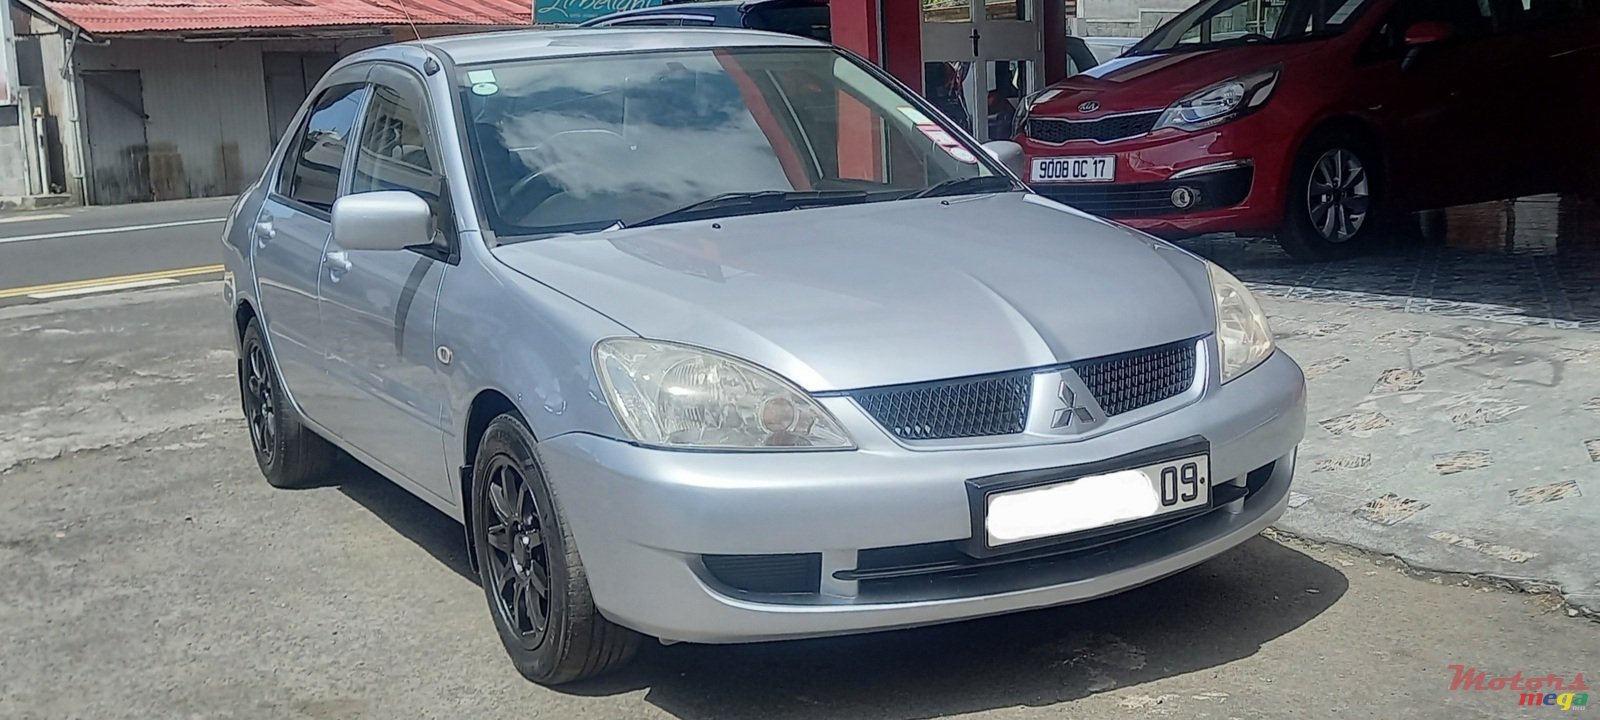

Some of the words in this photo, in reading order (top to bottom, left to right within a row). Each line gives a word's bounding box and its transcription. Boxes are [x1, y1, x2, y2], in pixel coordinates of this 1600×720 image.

[1039, 160, 1069, 178] 9008
[1073, 160, 1088, 178] OC
[1093, 160, 1106, 177] 17
[1161, 462, 1198, 507] 09
